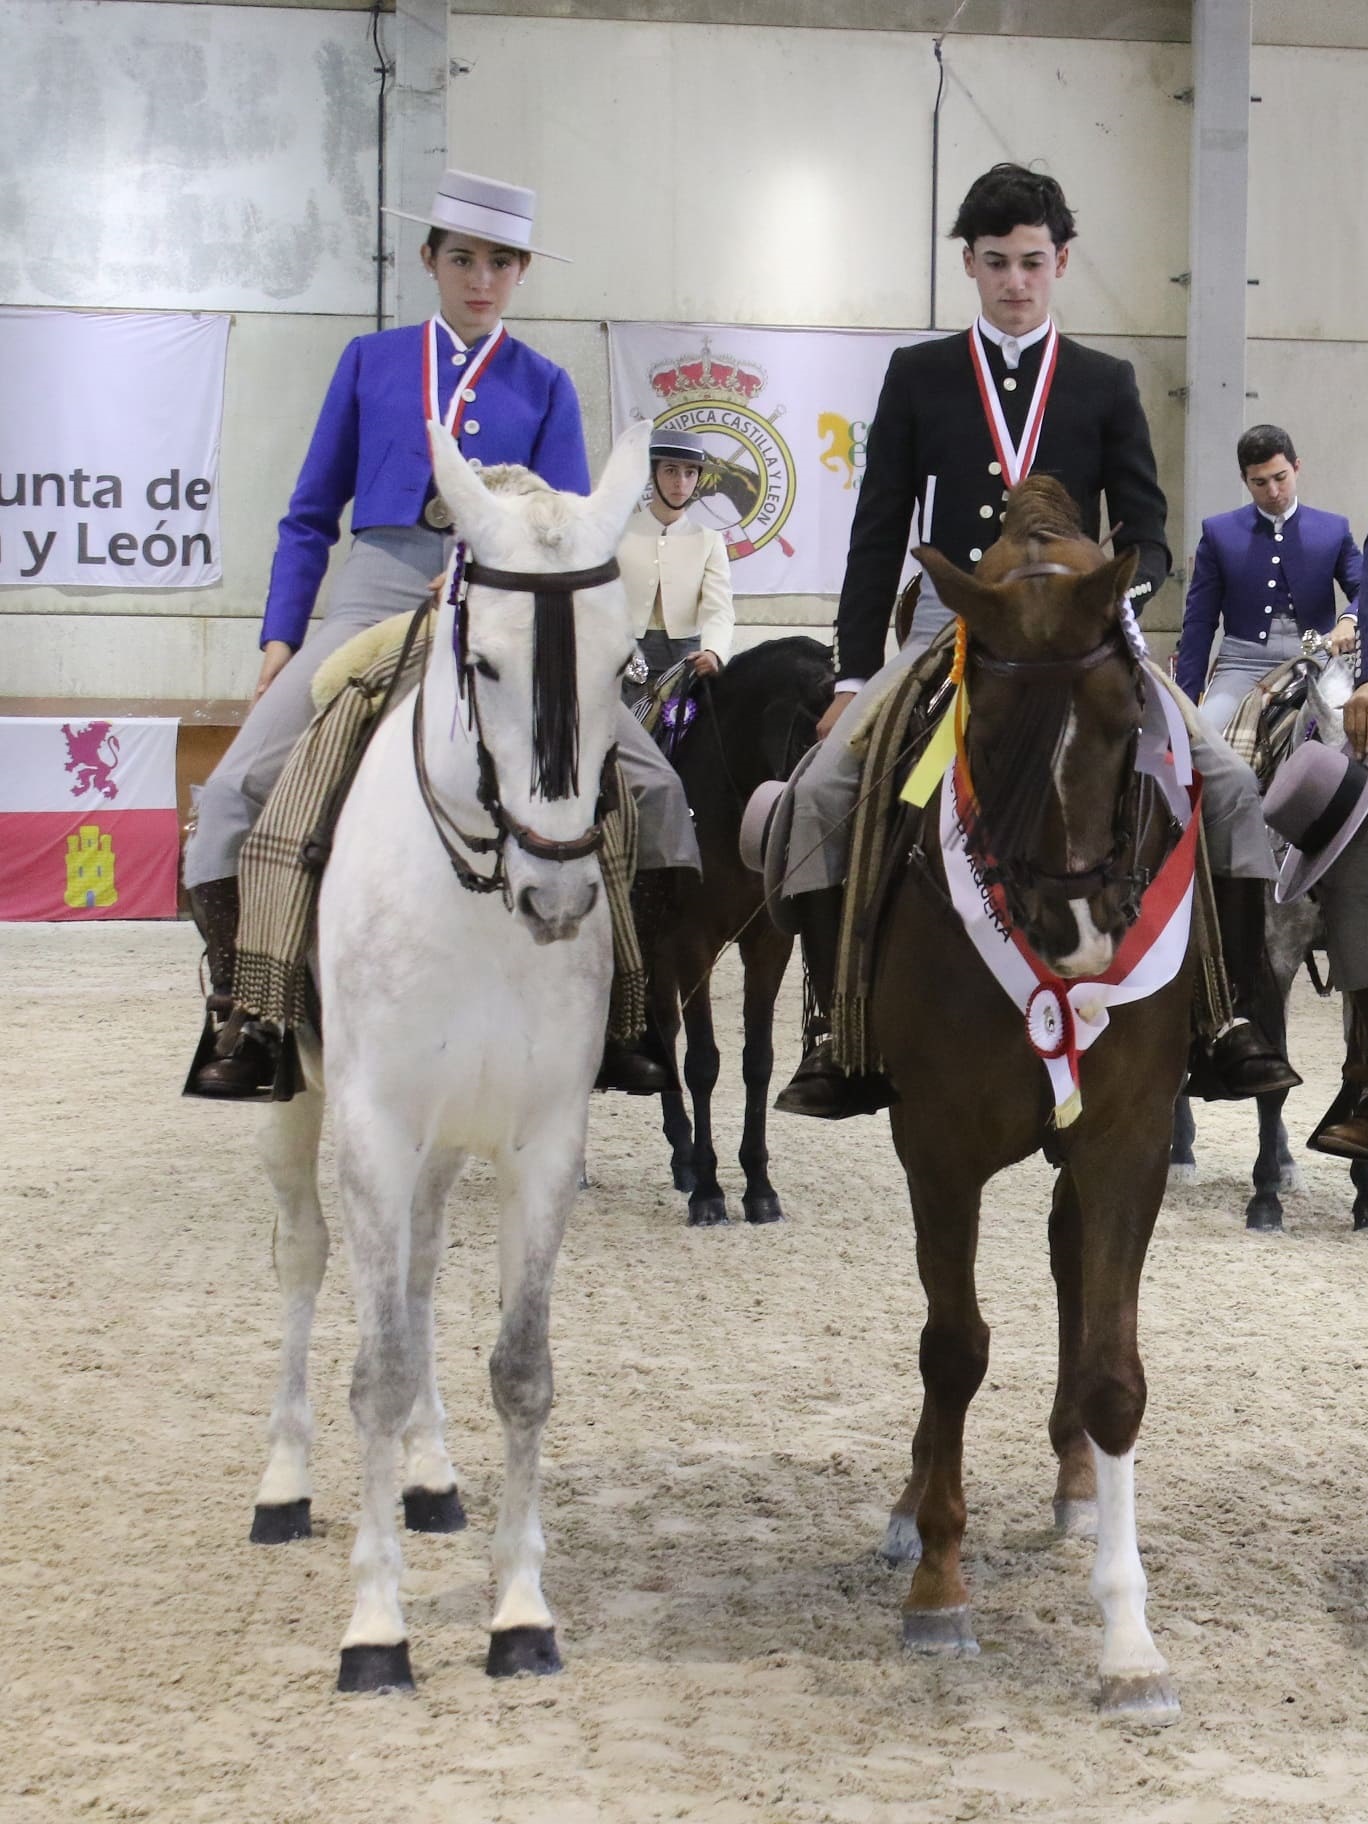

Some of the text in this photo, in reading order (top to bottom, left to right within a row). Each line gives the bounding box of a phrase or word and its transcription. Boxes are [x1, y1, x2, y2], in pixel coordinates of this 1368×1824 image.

[721, 412, 778, 468] CASTILLA
[0, 468, 211, 511] unta de
[768, 470, 782, 480] Y
[757, 485, 781, 526] LEON
[20, 519, 212, 577] y León
[964, 849, 1012, 943] AQUERA
